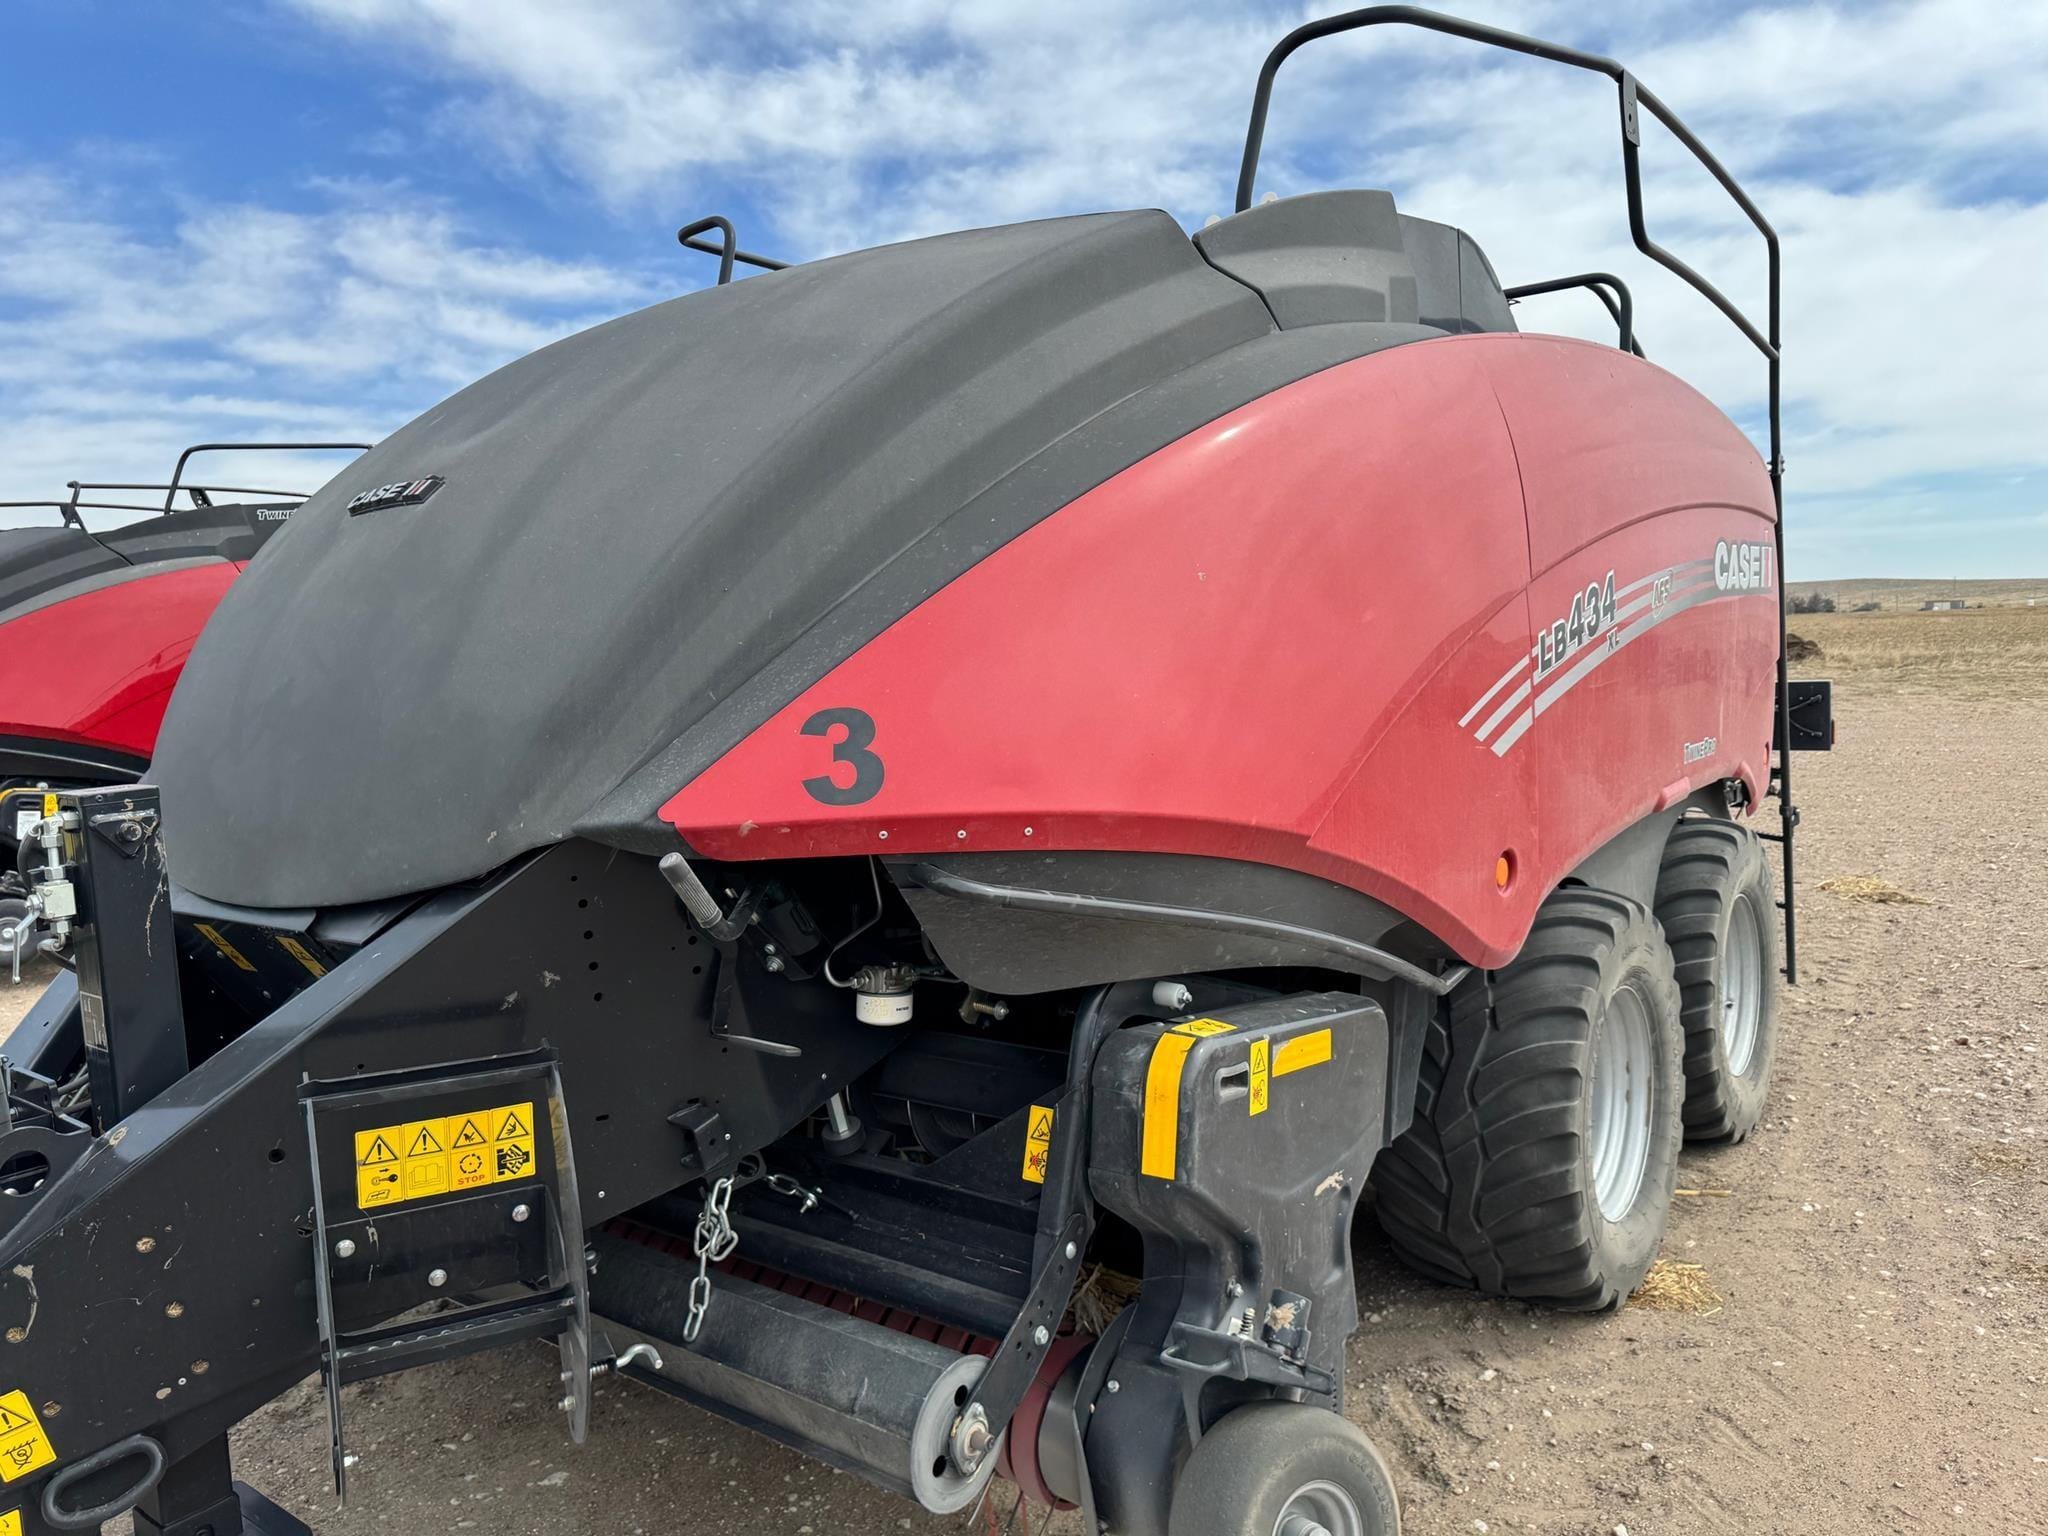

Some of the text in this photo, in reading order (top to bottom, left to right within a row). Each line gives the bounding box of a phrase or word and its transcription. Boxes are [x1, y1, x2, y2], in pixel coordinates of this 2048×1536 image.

[347, 482, 407, 509] CASE
[257, 508, 298, 520] TWINE
[1714, 541, 1760, 590] CASE
[1538, 569, 1616, 674] LB434
[1606, 627, 1619, 652] XL
[800, 707, 885, 806] 3
[457, 1174, 485, 1186] STOP
